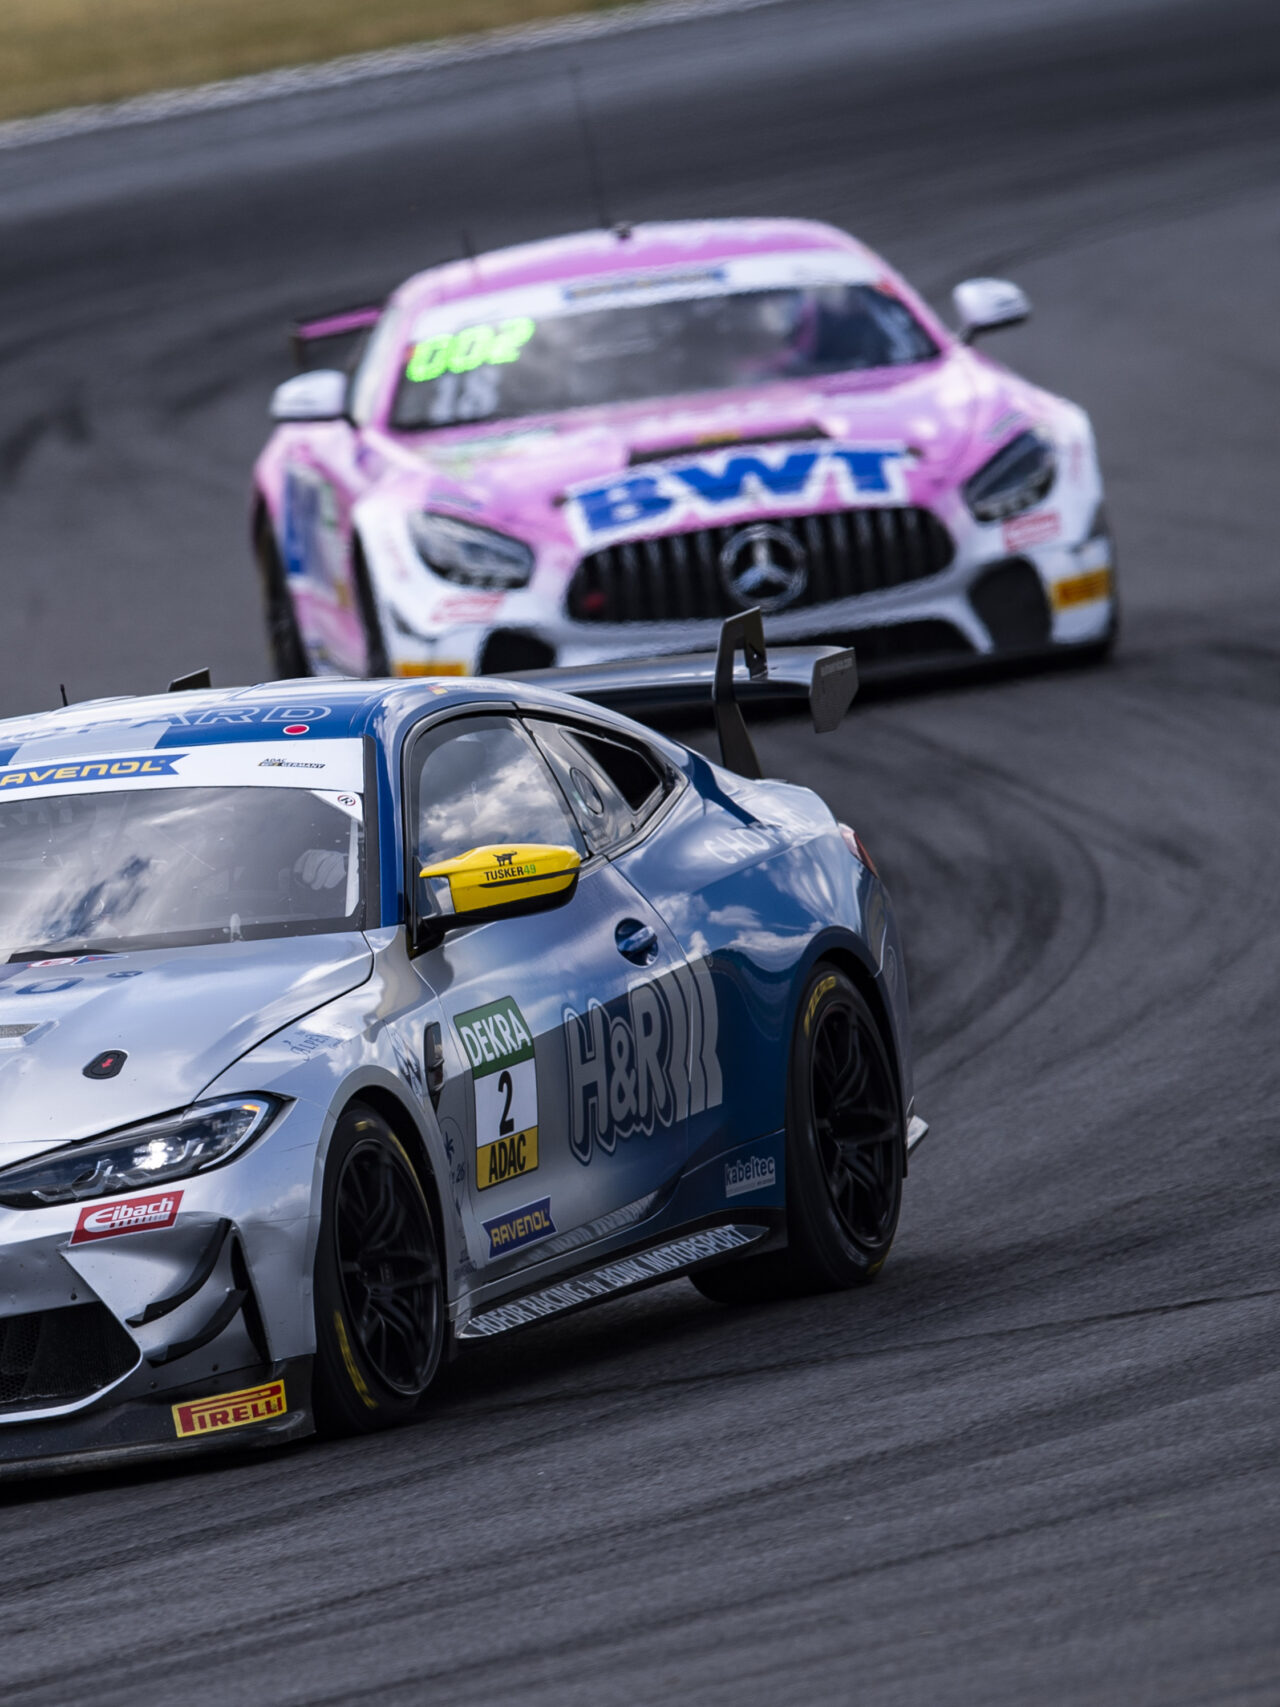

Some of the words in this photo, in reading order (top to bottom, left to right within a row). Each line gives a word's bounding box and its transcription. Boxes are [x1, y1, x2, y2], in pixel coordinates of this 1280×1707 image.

[406, 317, 536, 383] 002
[572, 450, 905, 533] BWT
[484, 864, 537, 881] TUSKER49
[460, 1009, 532, 1067] DEKRA
[561, 976, 674, 1167] H&R
[497, 1070, 515, 1137] 2
[488, 1134, 527, 1183] ADAC
[724, 1156, 776, 1187] kabeltec
[83, 1197, 174, 1233] Eibach
[490, 1209, 552, 1248] RAVENOL
[475, 1304, 535, 1335] HOFOR
[530, 1281, 590, 1317] RACING
[594, 1260, 650, 1288] BONK
[641, 1223, 752, 1273] MOTORSPORT
[176, 1384, 284, 1434] PIRELLI
